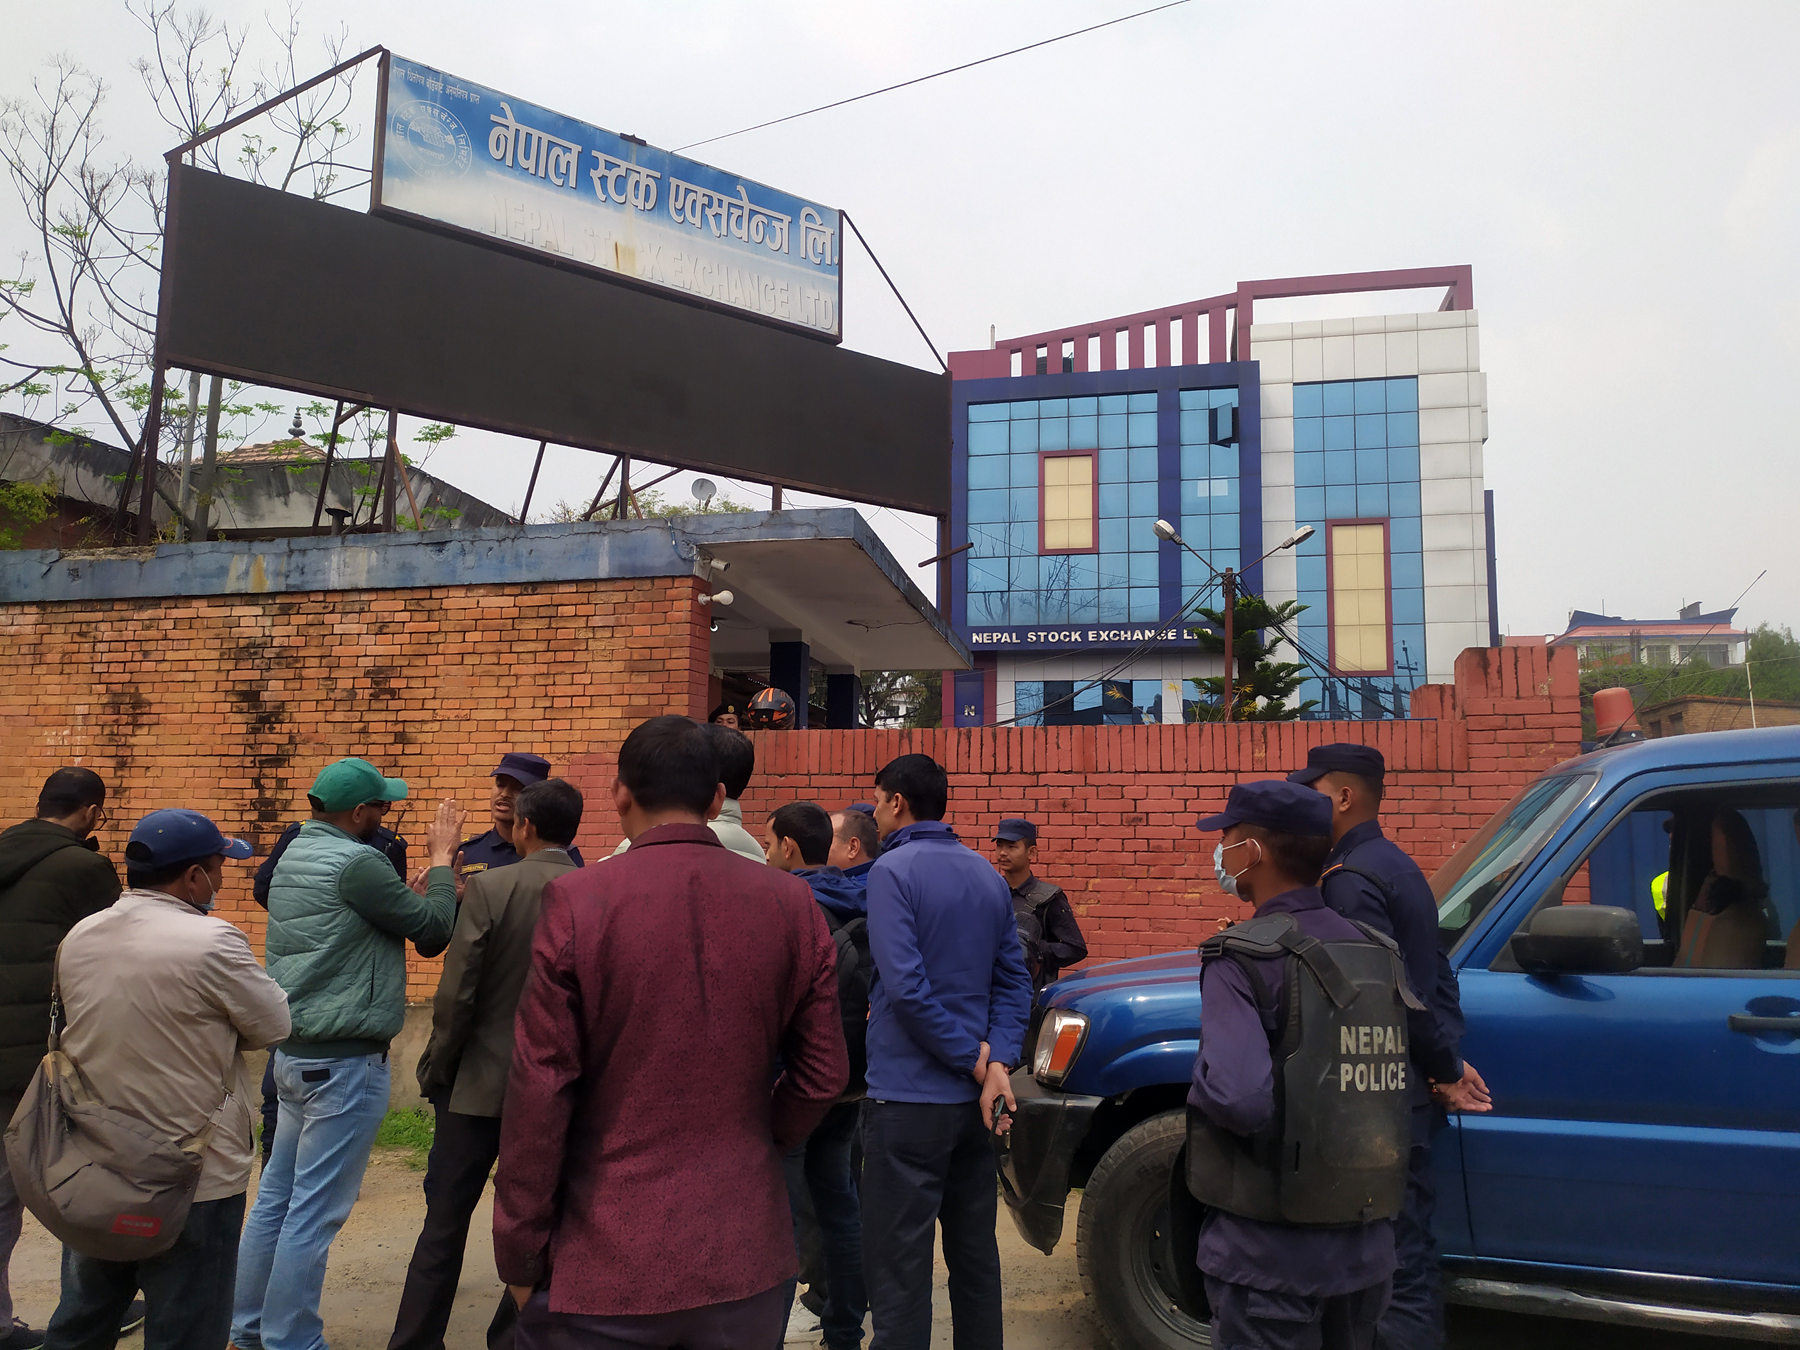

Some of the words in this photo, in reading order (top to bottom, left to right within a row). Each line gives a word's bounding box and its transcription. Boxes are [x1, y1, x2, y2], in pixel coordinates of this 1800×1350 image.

[488, 101, 582, 189] नेपाल
[590, 150, 661, 212] स्टक
[669, 177, 792, 254] एक्सचेन्ज
[488, 194, 575, 257] NEPAL
[583, 226, 664, 283] STCK
[671, 252, 790, 319] EXCHANGE
[796, 286, 835, 331] LTD
[971, 631, 1021, 644] NEPAL
[1027, 630, 1082, 643] STOCK
[1087, 628, 1177, 642] EXCHANGE
[1340, 1025, 1406, 1055] NEPAL
[1340, 1061, 1406, 1092] POLICE
